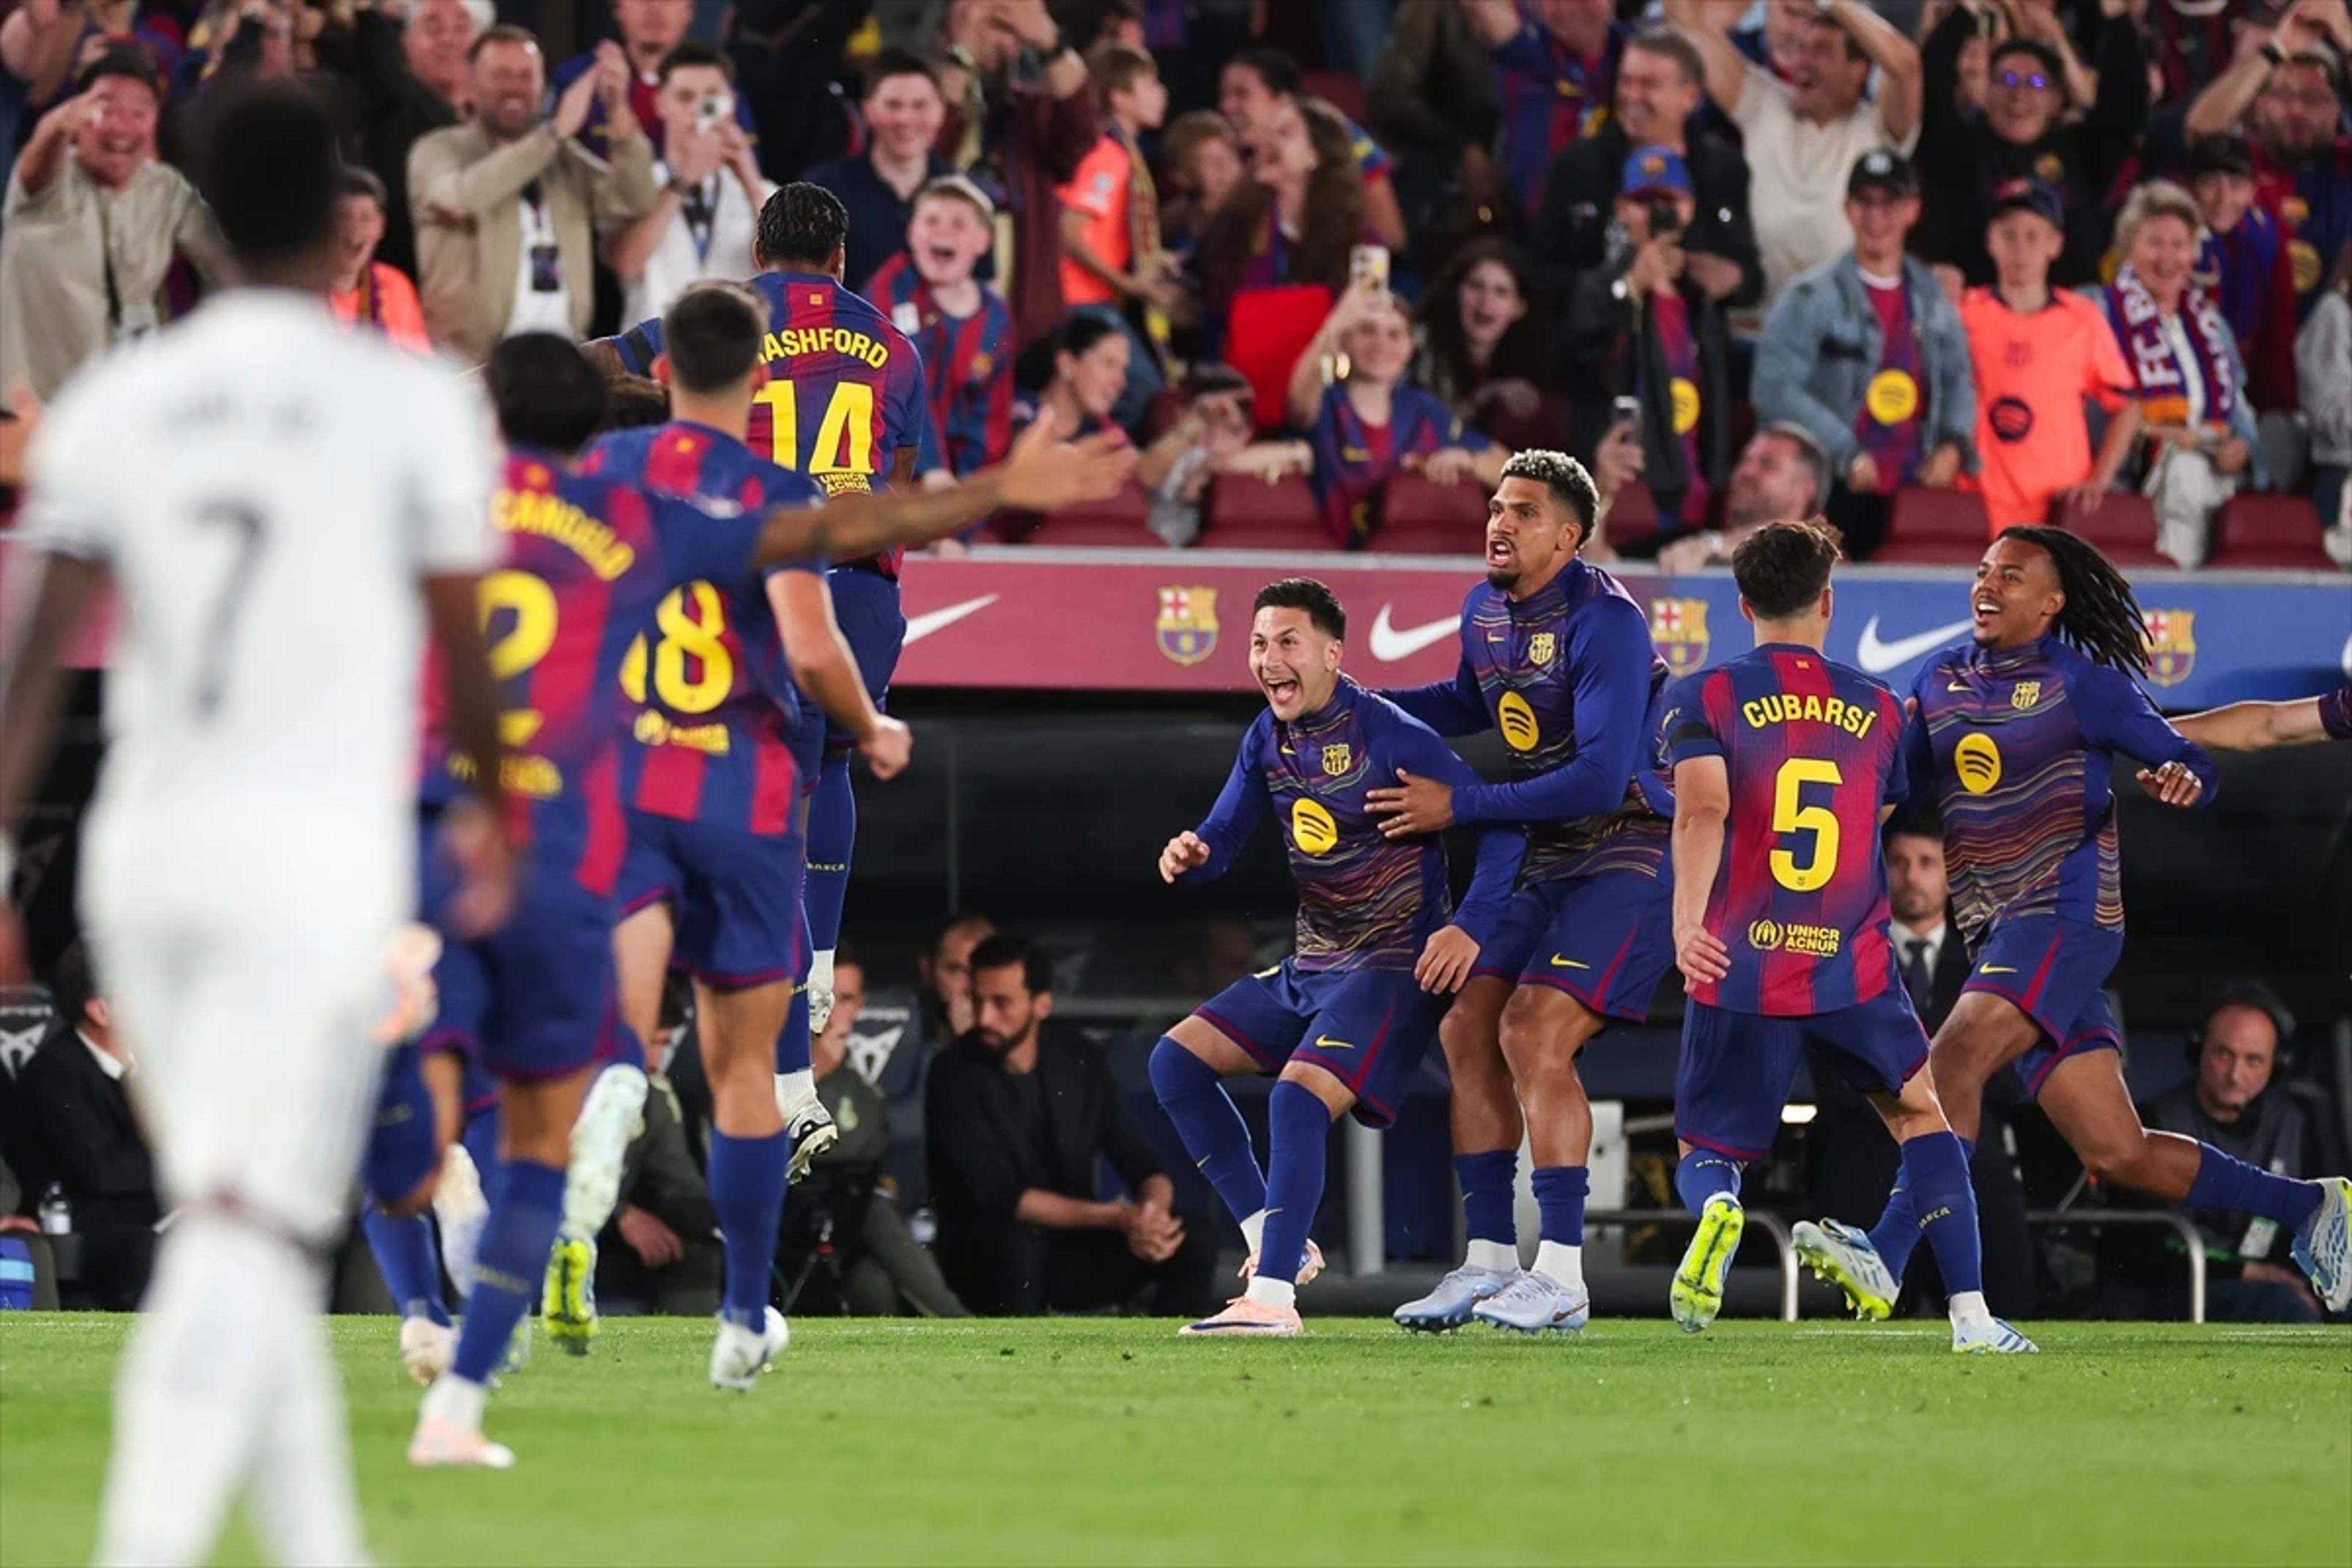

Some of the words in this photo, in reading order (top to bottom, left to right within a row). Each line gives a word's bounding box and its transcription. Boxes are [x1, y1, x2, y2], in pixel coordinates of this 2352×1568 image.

[758, 328, 889, 369] ASHFORD
[752, 379, 875, 475] 14
[190, 497, 268, 726] 7
[1742, 693, 1877, 739] CUBARSÍ
[1769, 757, 1844, 892] 5
[1785, 936, 1838, 953] ACNUR
[1787, 923, 1840, 941] UNHCR
